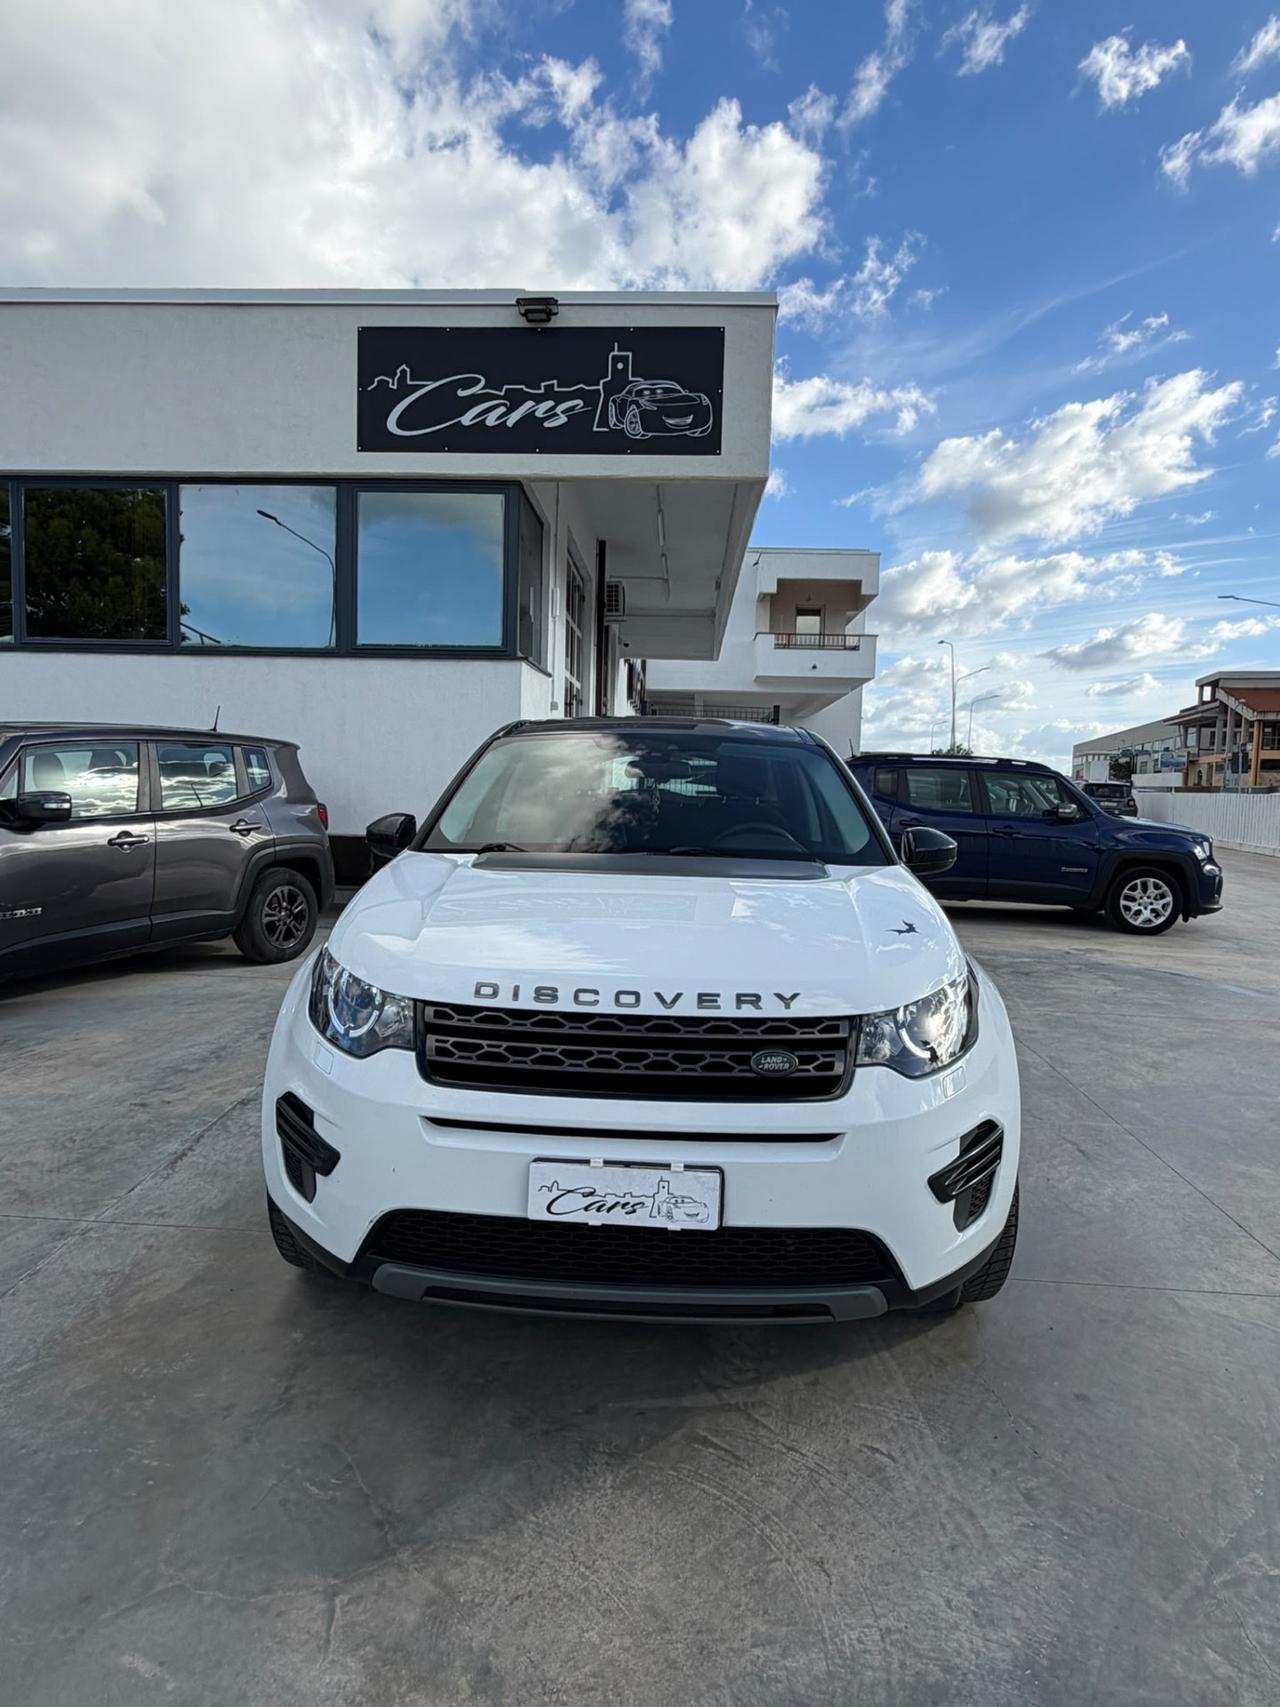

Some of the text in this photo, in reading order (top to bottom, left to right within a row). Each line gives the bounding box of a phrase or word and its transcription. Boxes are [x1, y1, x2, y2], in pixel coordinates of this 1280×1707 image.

[386, 374, 592, 436] Cars
[474, 981, 800, 1010] DISCOVERY
[546, 1186, 649, 1216] Cars
